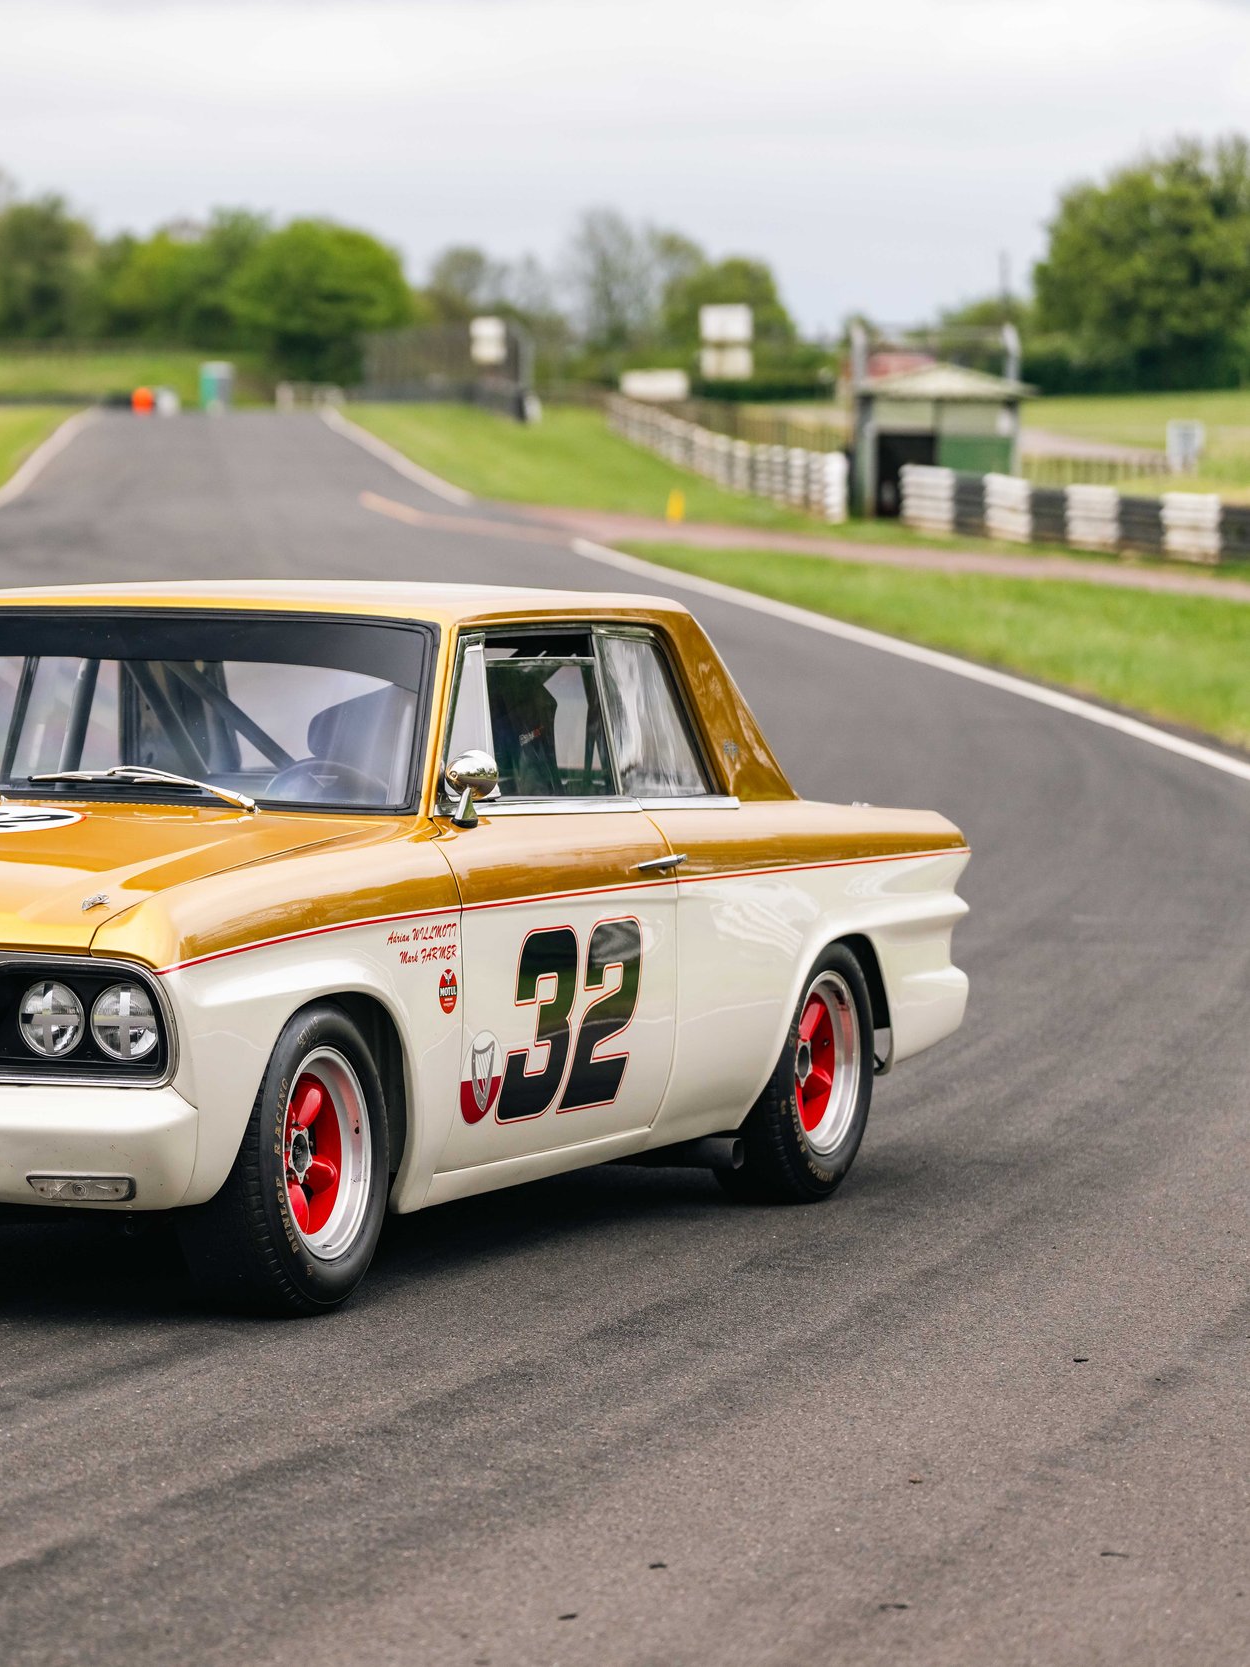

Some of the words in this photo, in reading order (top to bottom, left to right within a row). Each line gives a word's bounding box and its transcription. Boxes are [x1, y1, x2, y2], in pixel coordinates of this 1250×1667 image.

[387, 930, 410, 946] Adrian
[412, 922, 457, 941] WILLMOTT
[399, 949, 418, 964] Mark
[421, 944, 457, 964] FARMER
[439, 985, 457, 997] MOTUL
[495, 915, 642, 1125] 32
[273, 1077, 289, 1156] RACING
[790, 1095, 808, 1154] RACING
[275, 1175, 300, 1254] DUNLOP
